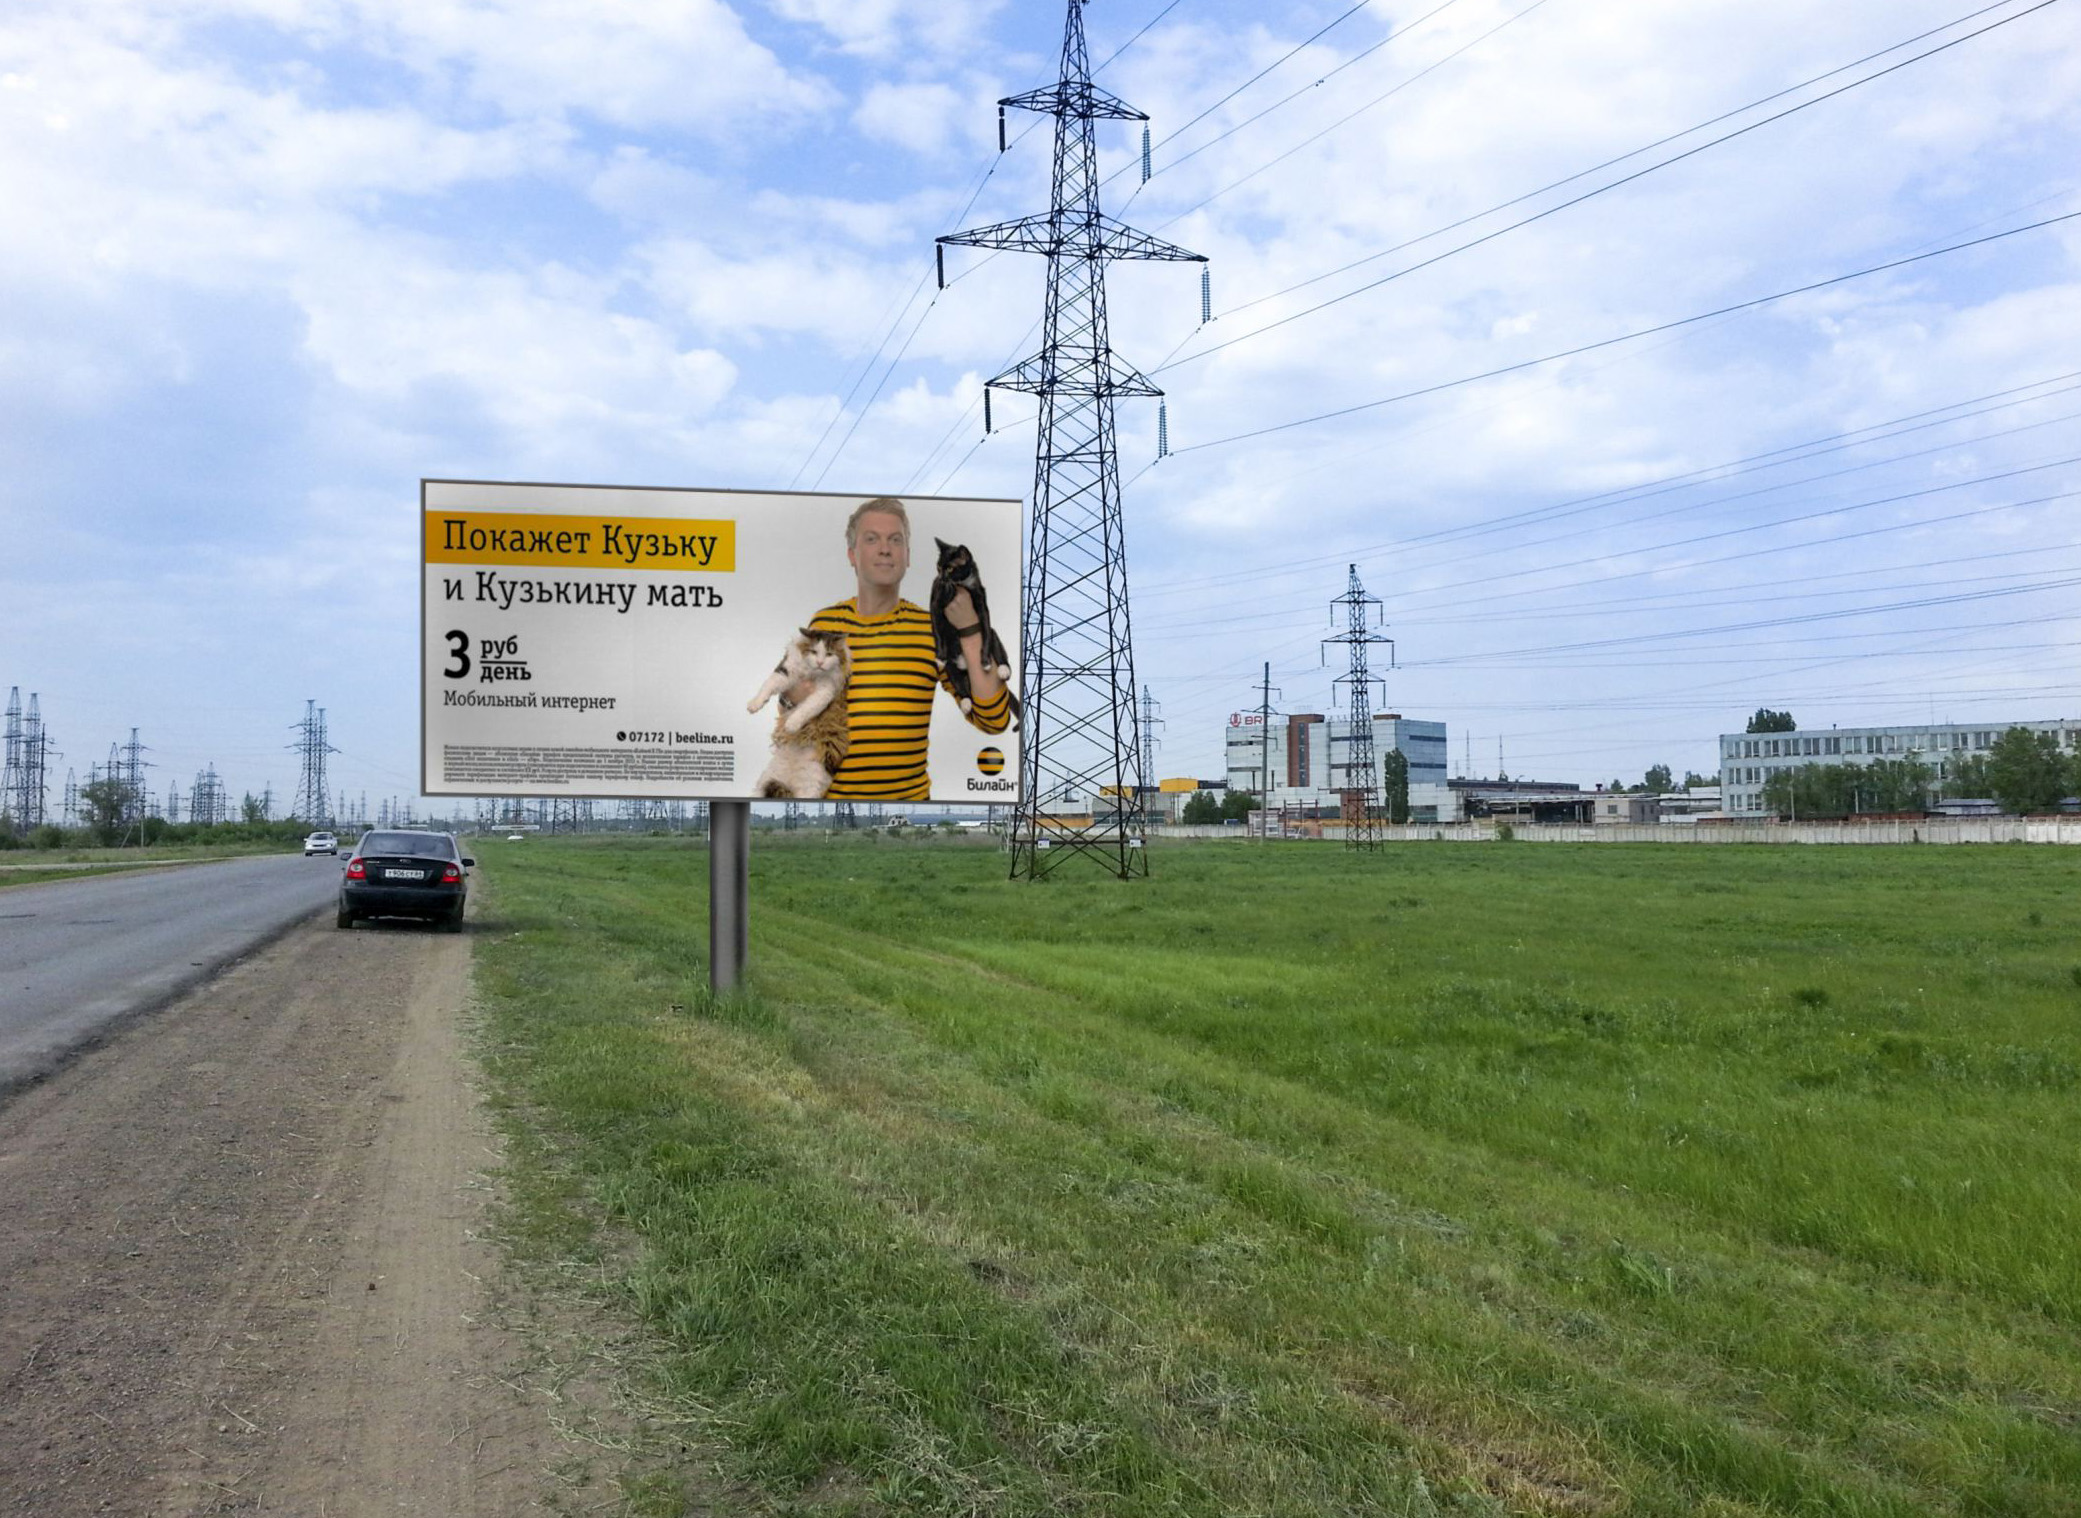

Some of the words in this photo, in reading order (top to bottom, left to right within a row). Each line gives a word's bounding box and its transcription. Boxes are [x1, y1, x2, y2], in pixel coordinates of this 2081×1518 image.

[443, 519, 591, 554] Покажет
[602, 525, 718, 566] Кузьку
[443, 578, 464, 601] и
[475, 571, 637, 614] Кузькину
[647, 584, 723, 608] мать
[443, 629, 471, 679] 3
[480, 635, 518, 659] руб
[480, 665, 532, 683] день
[443, 690, 538, 708] Мобильный
[541, 696, 616, 713] интернет
[628, 731, 665, 743] 07172
[675, 732, 734, 745] beeline.ru
[966, 778, 1014, 791] Билайн
